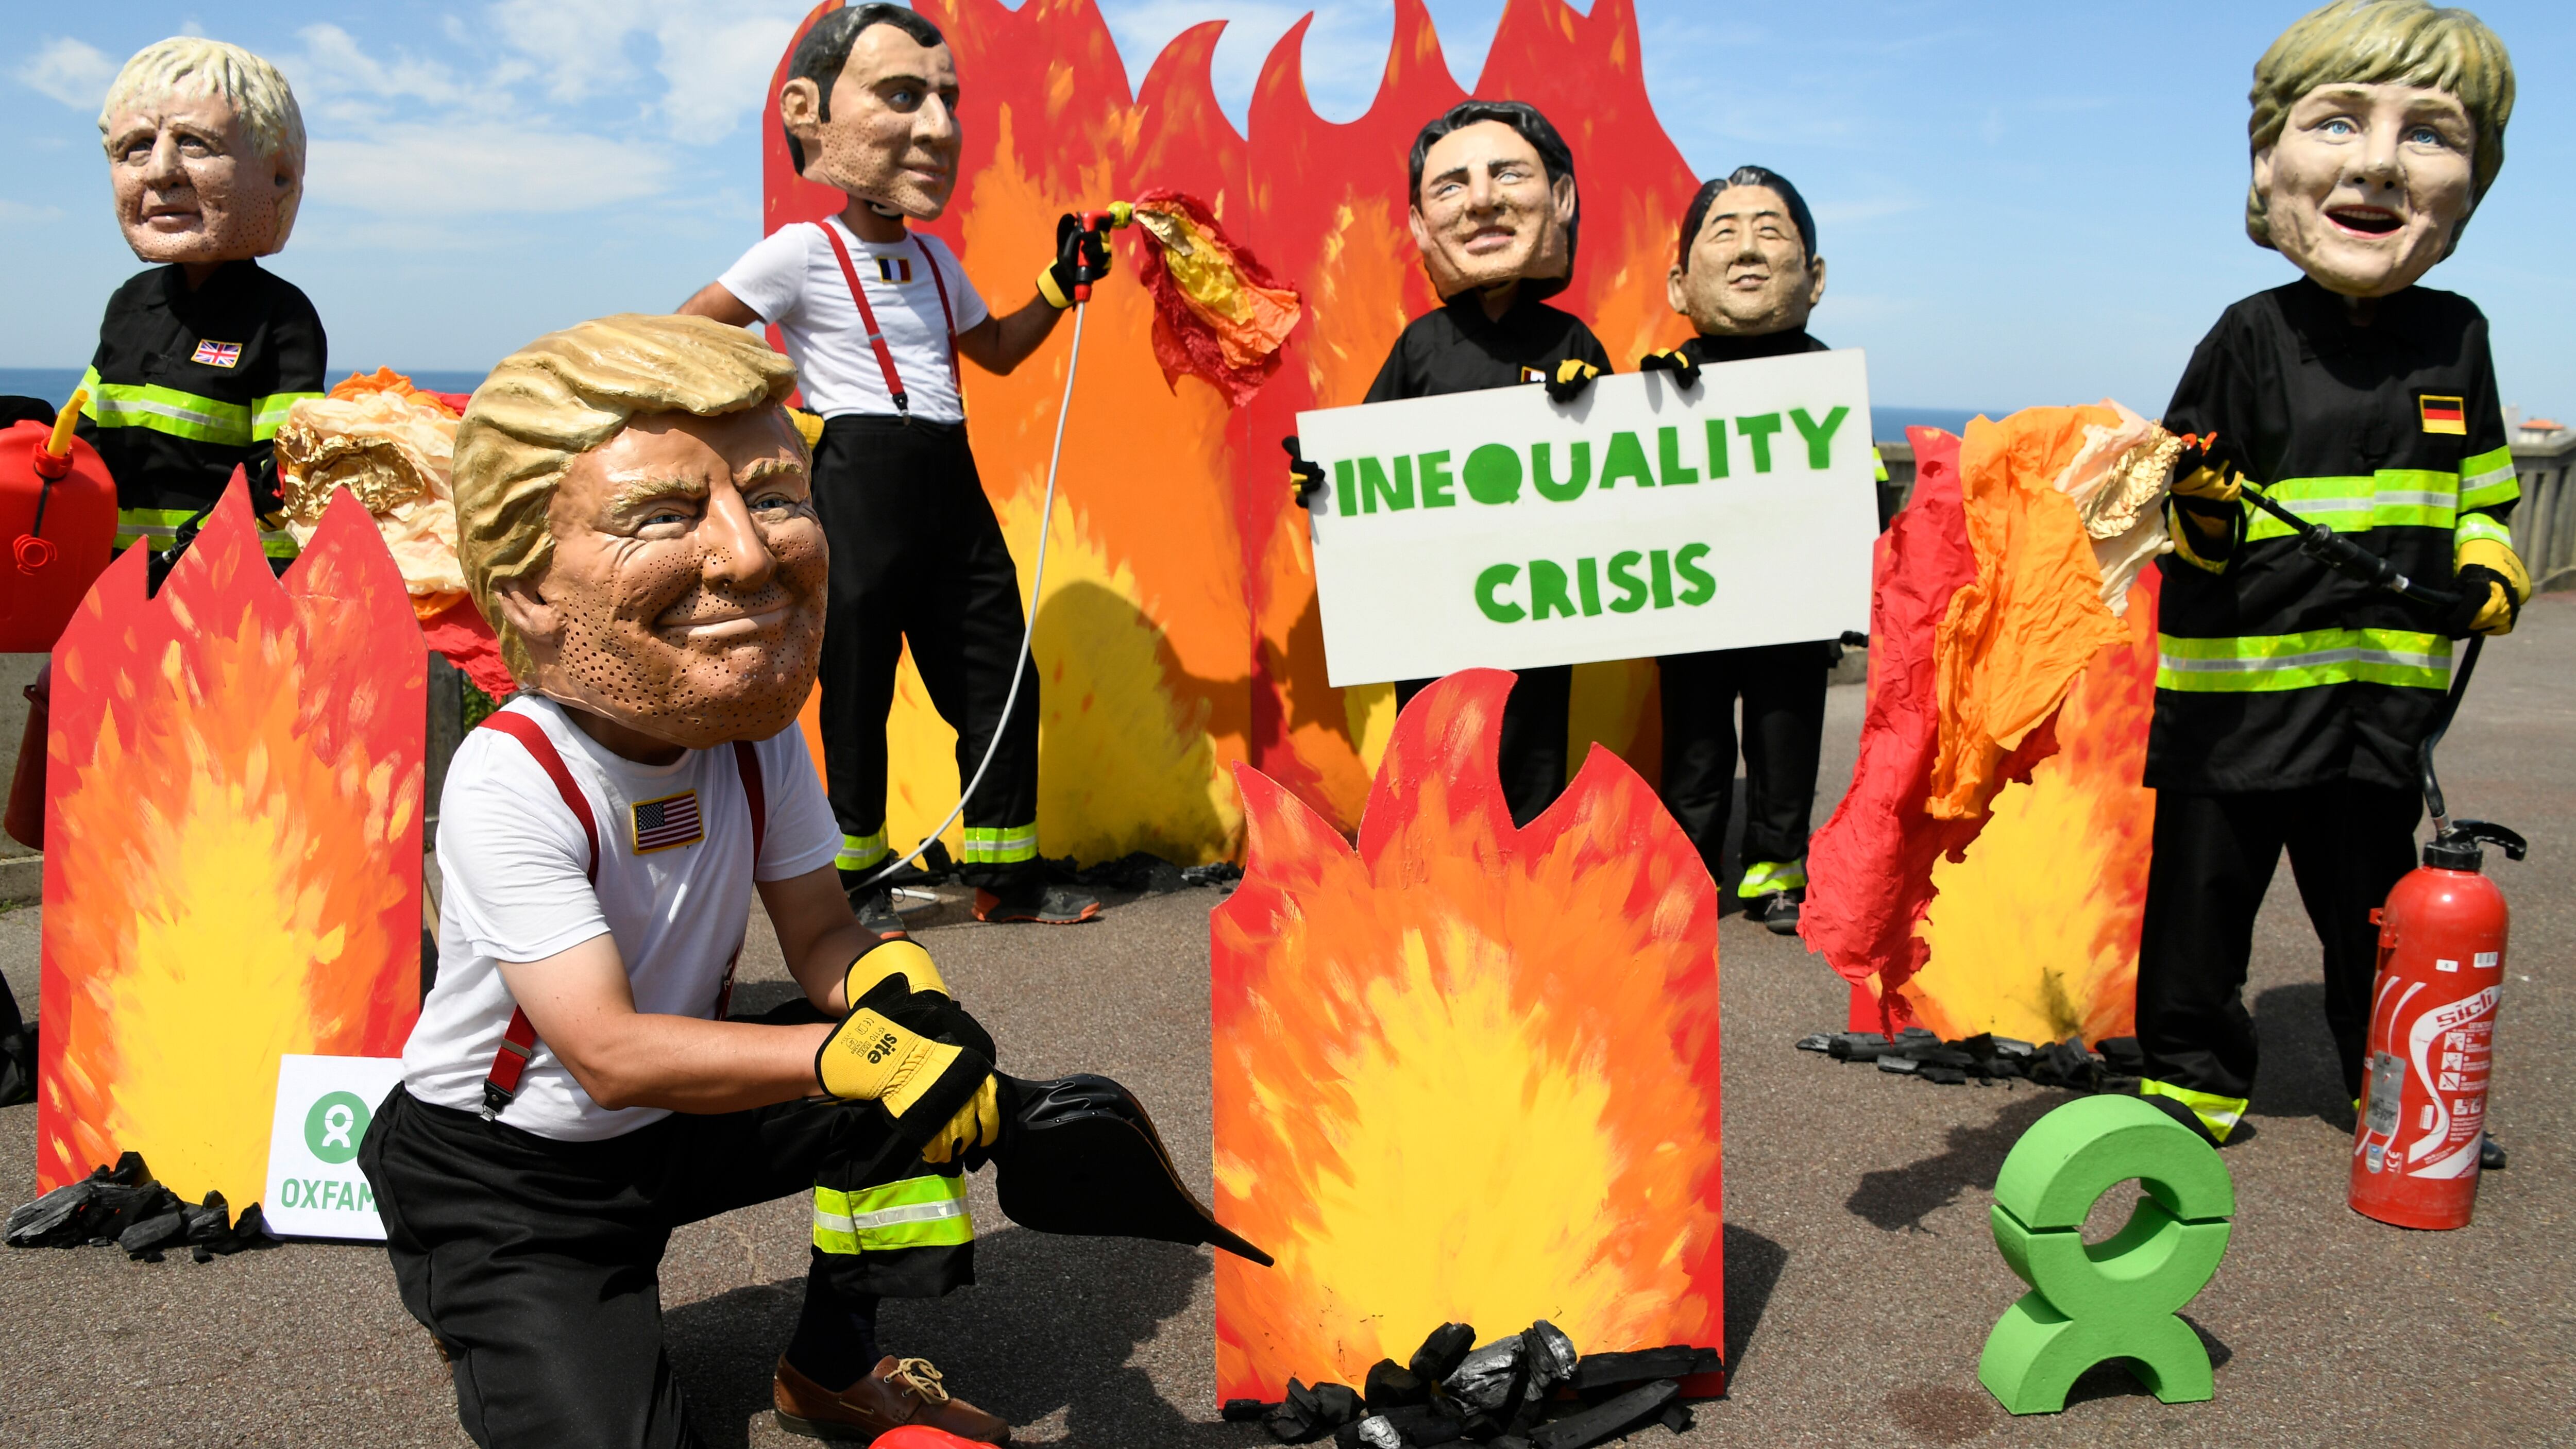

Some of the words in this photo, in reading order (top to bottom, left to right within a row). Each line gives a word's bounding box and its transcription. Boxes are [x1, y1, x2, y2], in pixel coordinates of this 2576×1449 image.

[1334, 406, 1850, 517] INEQUALITY
[1475, 543, 1717, 624] CRISIS
[2436, 989, 2493, 1027] sicli
[857, 1042, 871, 1056] 10/XL
[867, 1033, 897, 1064] site
[870, 1026, 886, 1041] KF110
